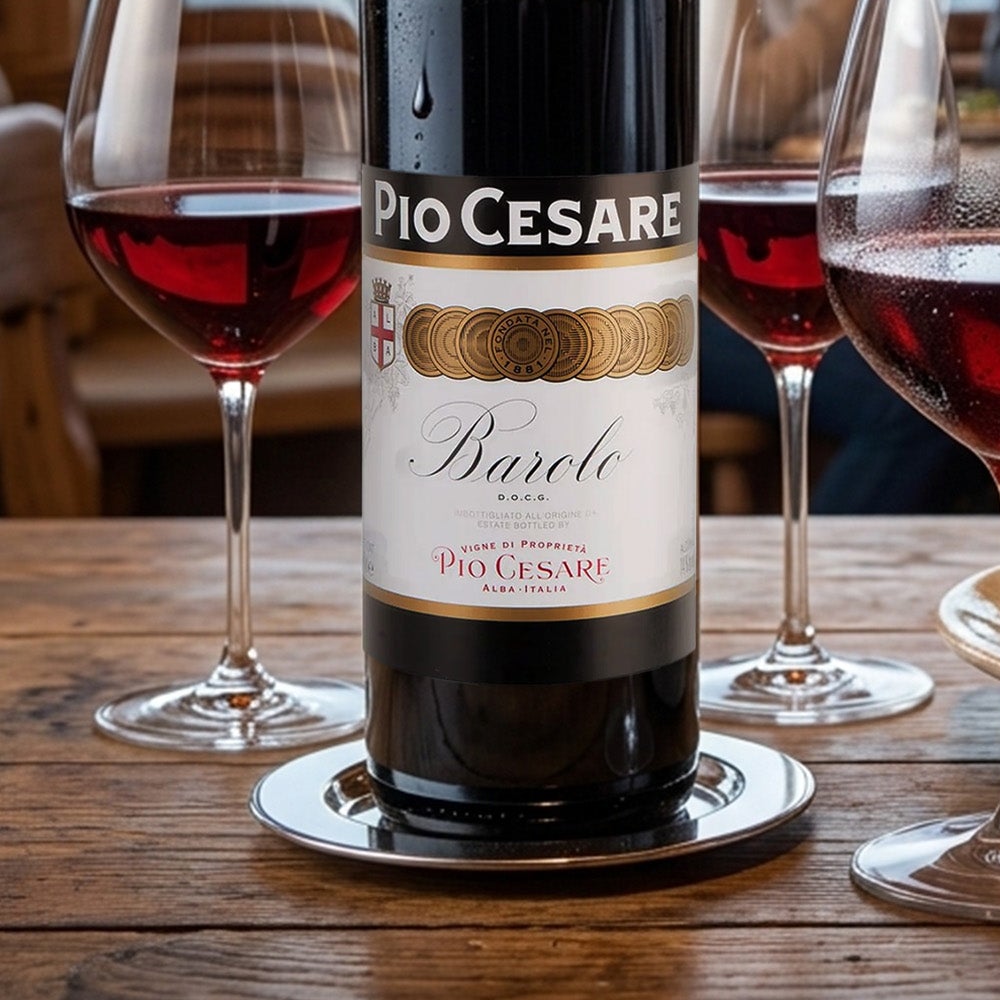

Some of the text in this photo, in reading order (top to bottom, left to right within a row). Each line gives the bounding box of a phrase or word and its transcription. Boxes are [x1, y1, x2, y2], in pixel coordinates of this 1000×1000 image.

[460, 186, 682, 246] CESARE
[494, 315, 553, 353] FONDATA NEL
[503, 360, 543, 374] 1881
[408, 398, 633, 484] Barolo
[497, 493, 550, 502] D.O.C.G.
[477, 520, 510, 530] ESTATE
[513, 521, 555, 530] BOTTLED
[460, 542, 497, 554] VIGNE
[502, 541, 515, 549] DI
[431, 545, 611, 585] PIO CESARE
